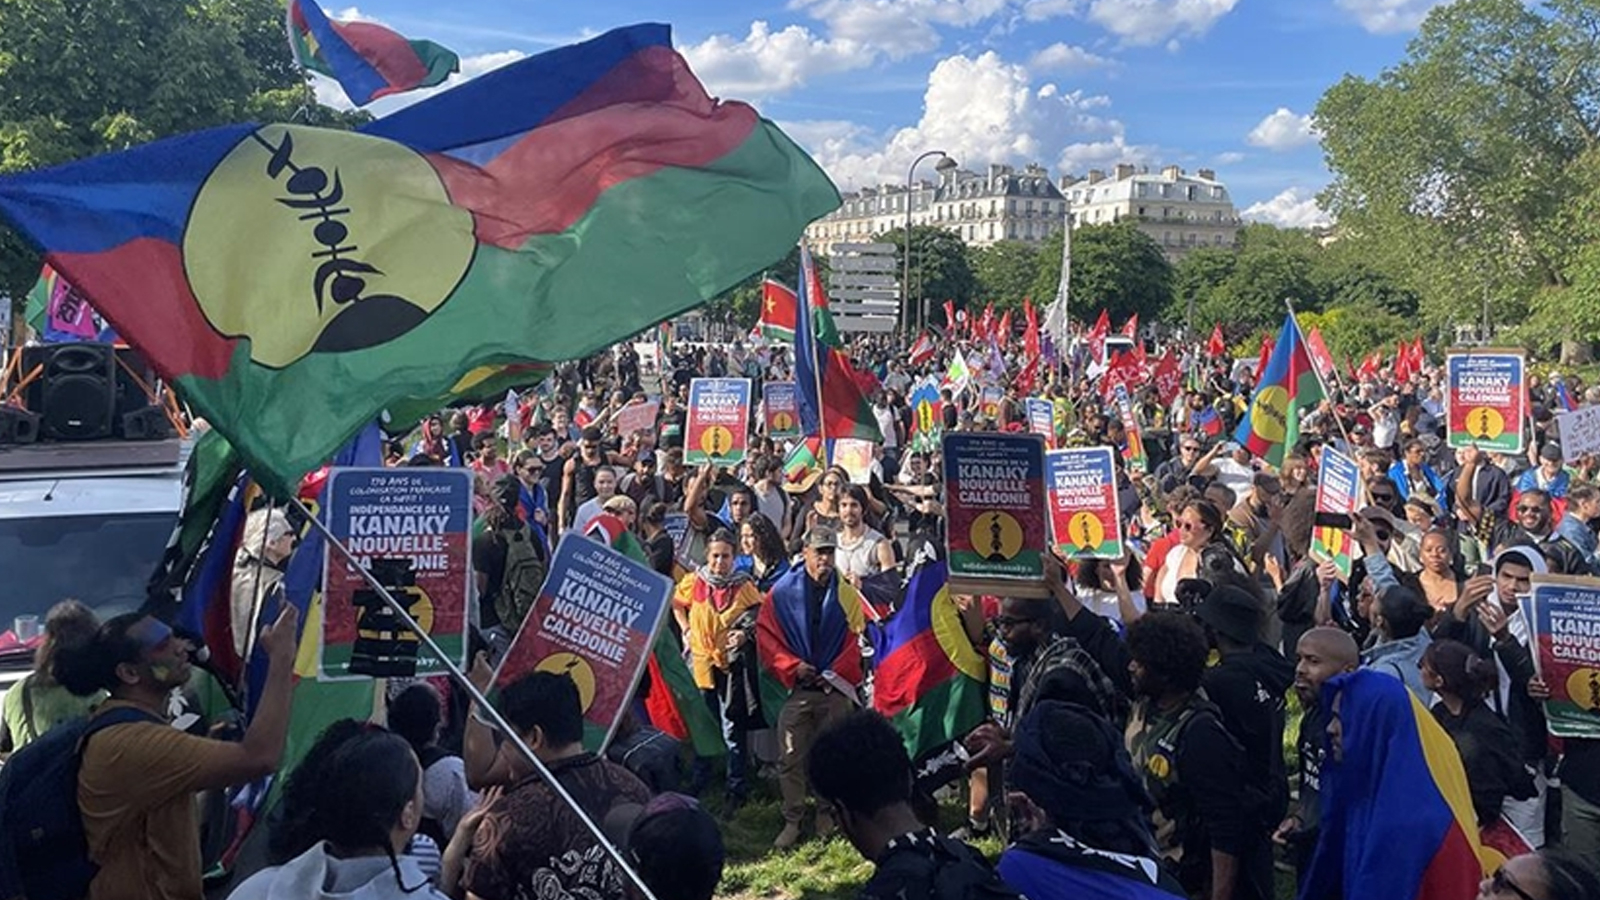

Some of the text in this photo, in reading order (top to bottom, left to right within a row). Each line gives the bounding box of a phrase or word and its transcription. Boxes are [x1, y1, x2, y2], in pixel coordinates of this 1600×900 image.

[958, 464, 1029, 480] KANAKY
[388, 477, 410, 486] ANS
[959, 479, 1030, 492] NOUVELLE-
[1055, 475, 1104, 488] KANAKY
[959, 490, 1031, 504] CALÉDONIE
[350, 504, 450, 514] INDÉPENDANCE DE LA
[350, 515, 450, 535] KANAKY
[350, 536, 449, 554] NOUVELLE-
[558, 578, 640, 628] KANAKY
[550, 597, 632, 644] NOUVELLE-
[543, 614, 627, 663] CALÉDONIE
